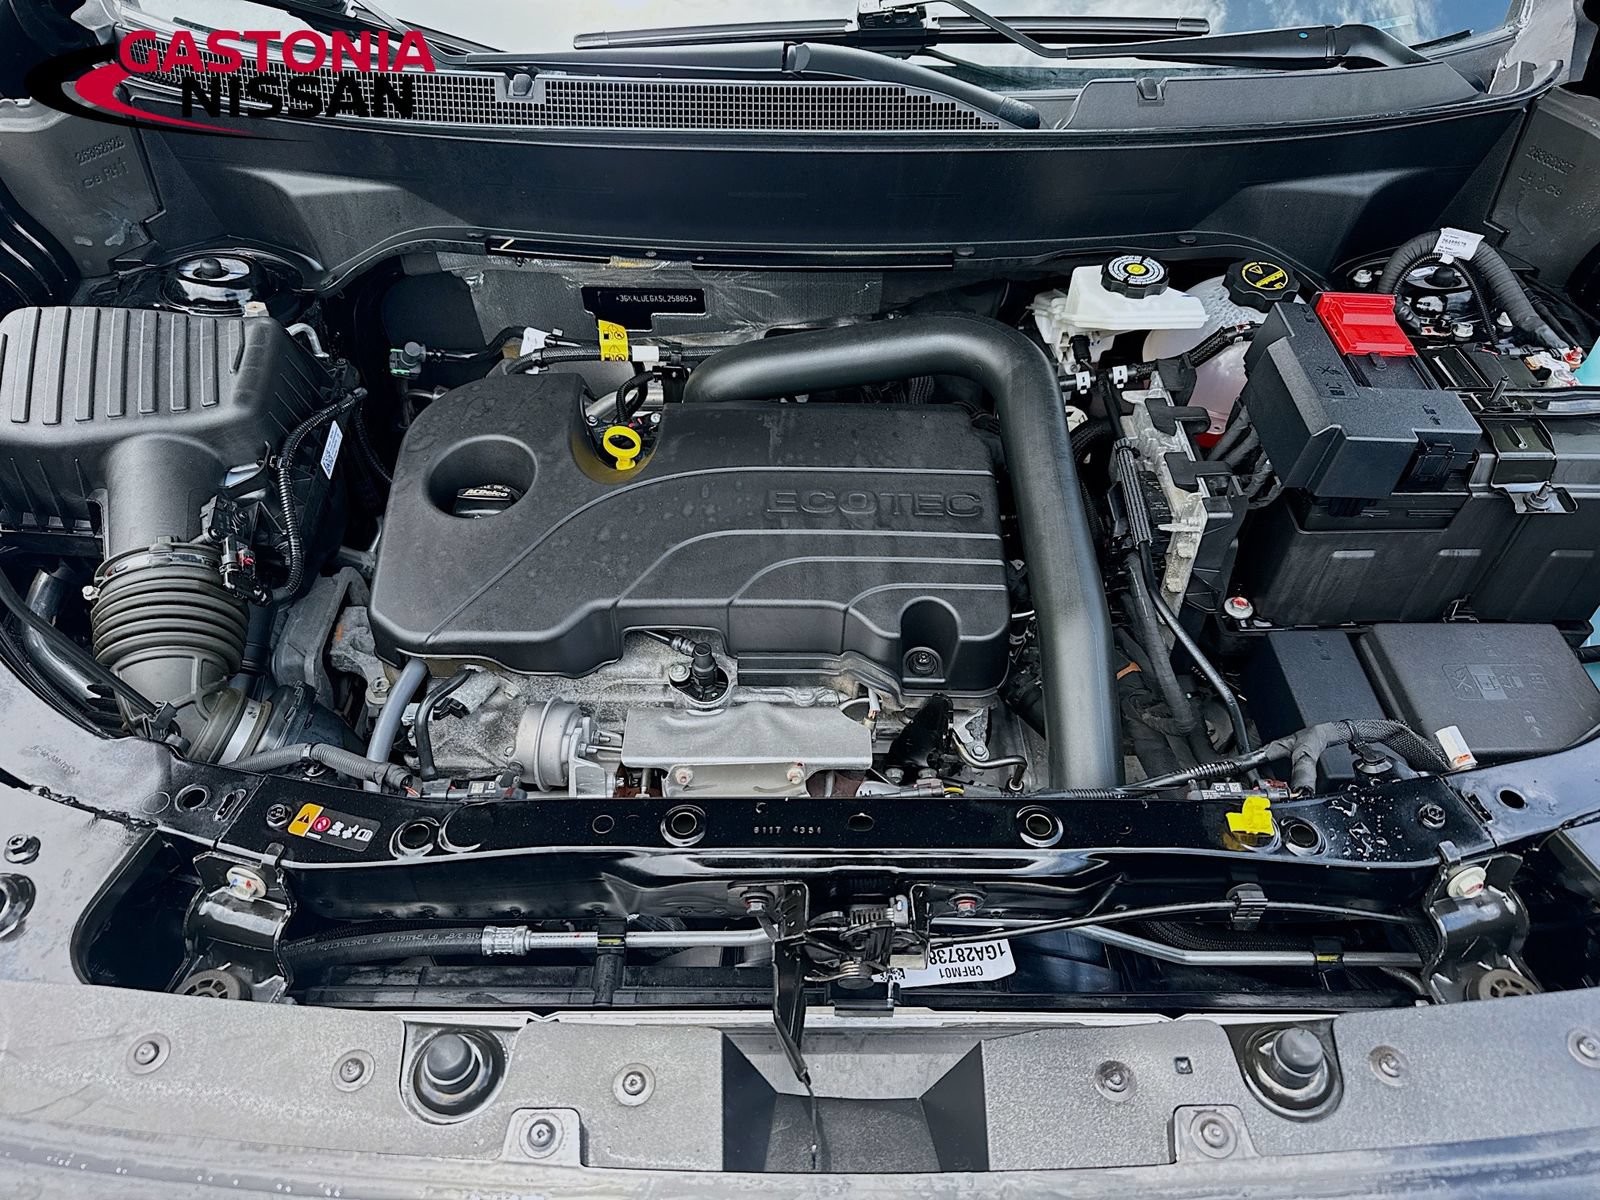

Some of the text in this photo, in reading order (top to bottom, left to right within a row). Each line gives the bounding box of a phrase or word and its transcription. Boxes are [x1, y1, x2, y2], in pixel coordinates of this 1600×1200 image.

[463, 489, 508, 497] ACDelco
[766, 490, 984, 518] ECOTEC
[929, 942, 1007, 966] 1GA28738
[939, 965, 984, 979] CRFM01
